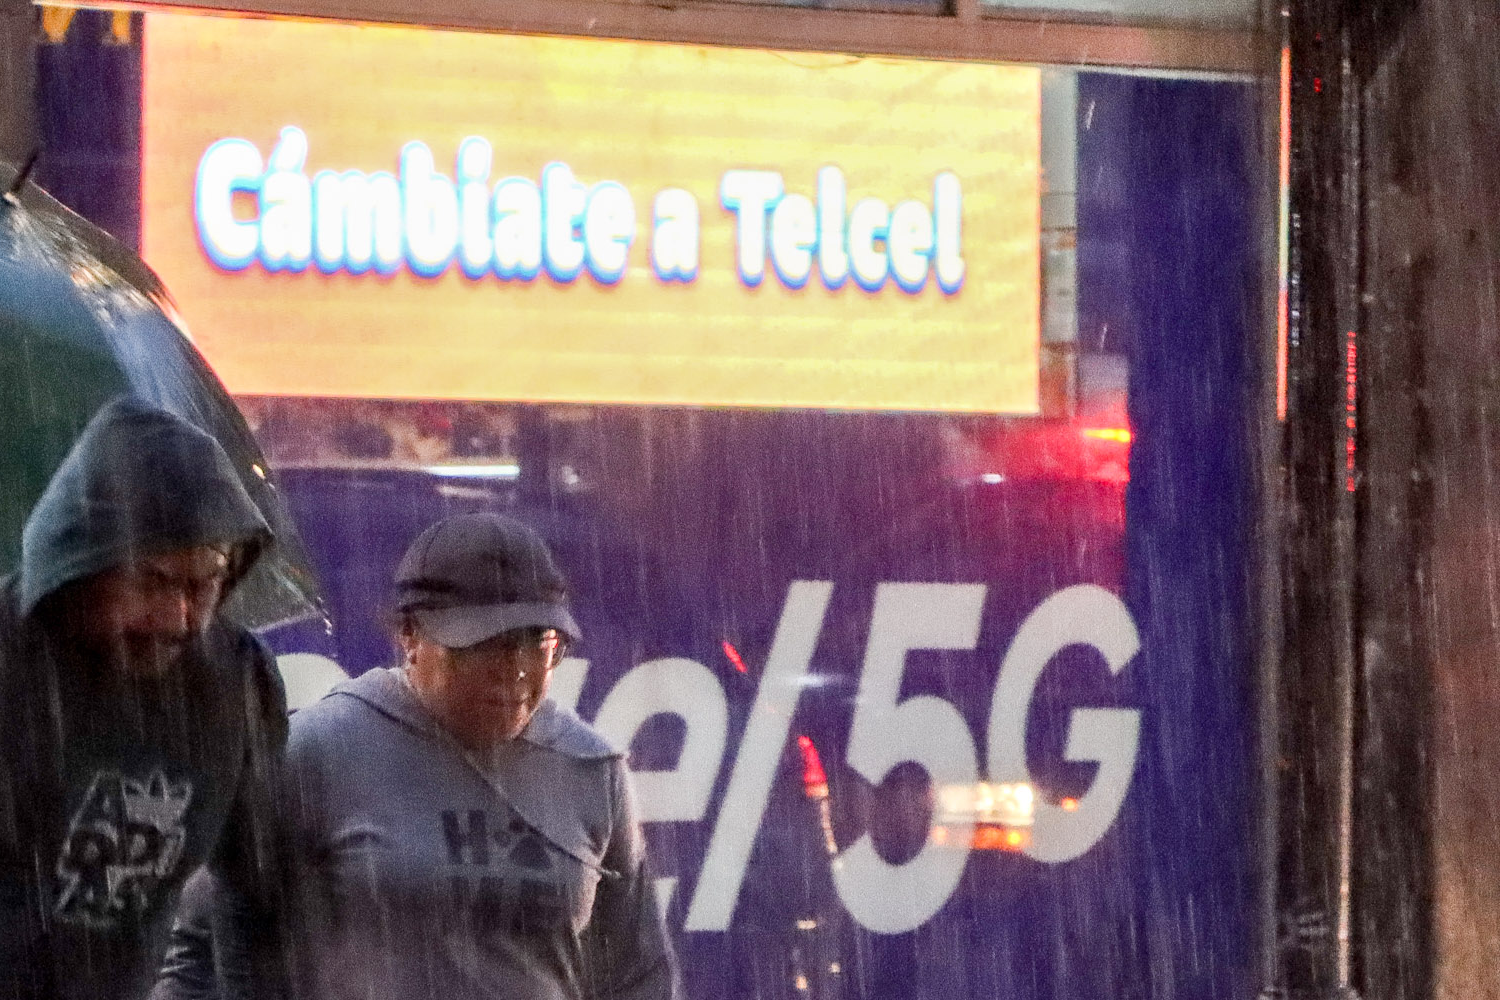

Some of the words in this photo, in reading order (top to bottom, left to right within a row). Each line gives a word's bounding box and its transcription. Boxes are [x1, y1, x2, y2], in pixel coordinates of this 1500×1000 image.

[198, 126, 634, 285] Cámbiate
[652, 188, 699, 283] a
[719, 166, 964, 295] Telcel
